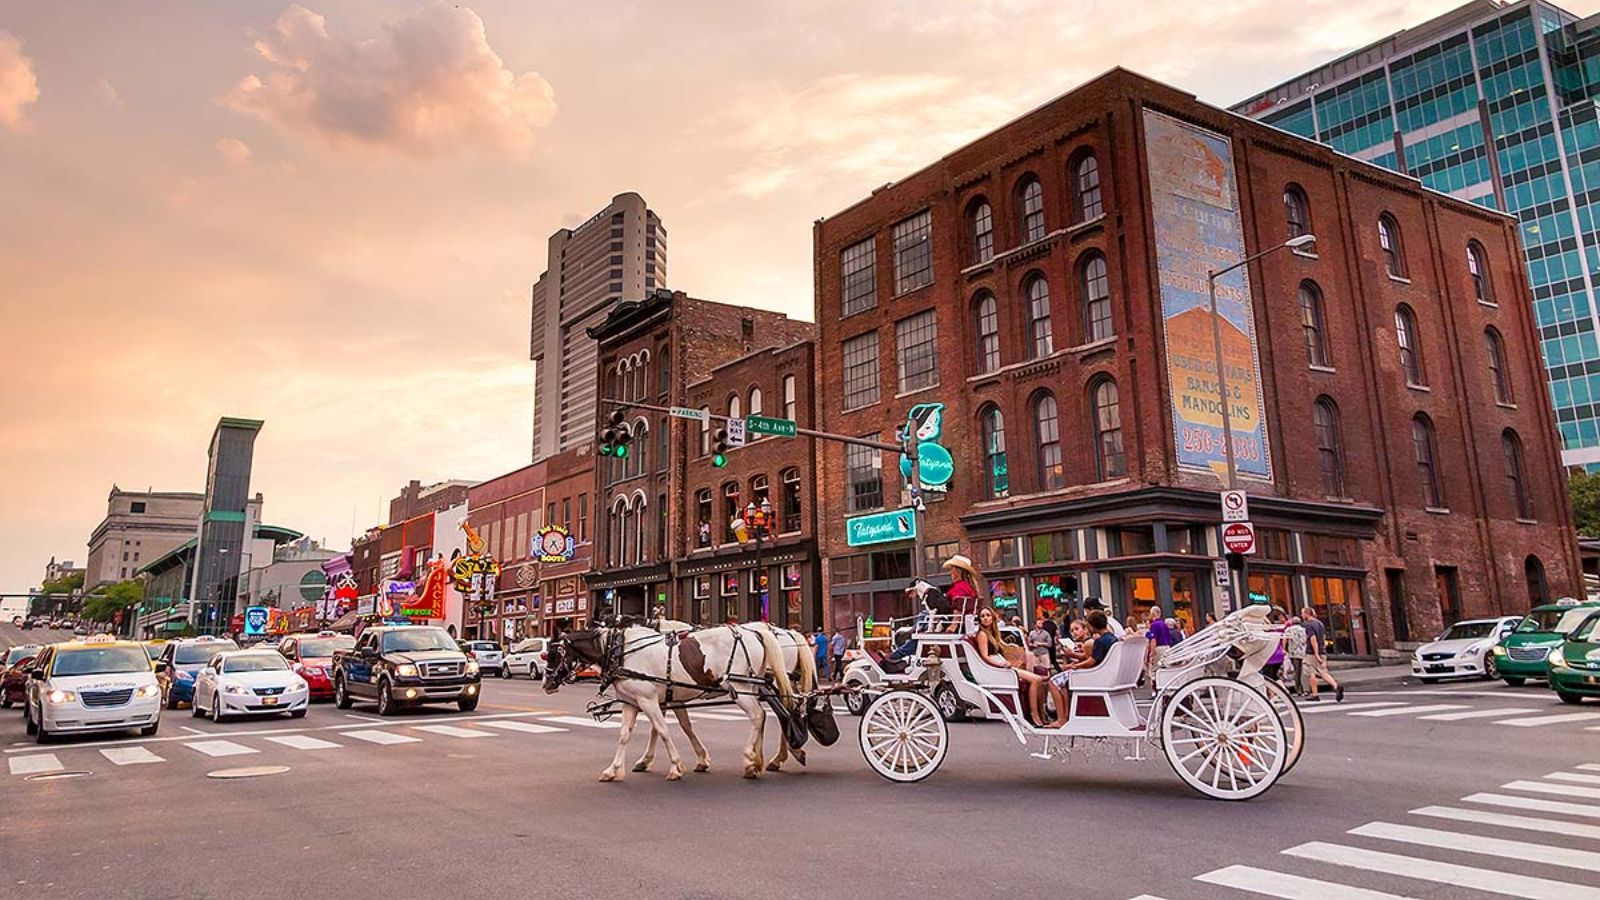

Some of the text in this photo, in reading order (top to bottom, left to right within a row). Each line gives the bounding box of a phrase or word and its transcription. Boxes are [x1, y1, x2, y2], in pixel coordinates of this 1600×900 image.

[1174, 353, 1253, 384] USED GUTARS
[1188, 376, 1242, 400] BANJOS &
[1183, 394, 1251, 420] MANDOINS
[729, 420, 743, 428] ONE
